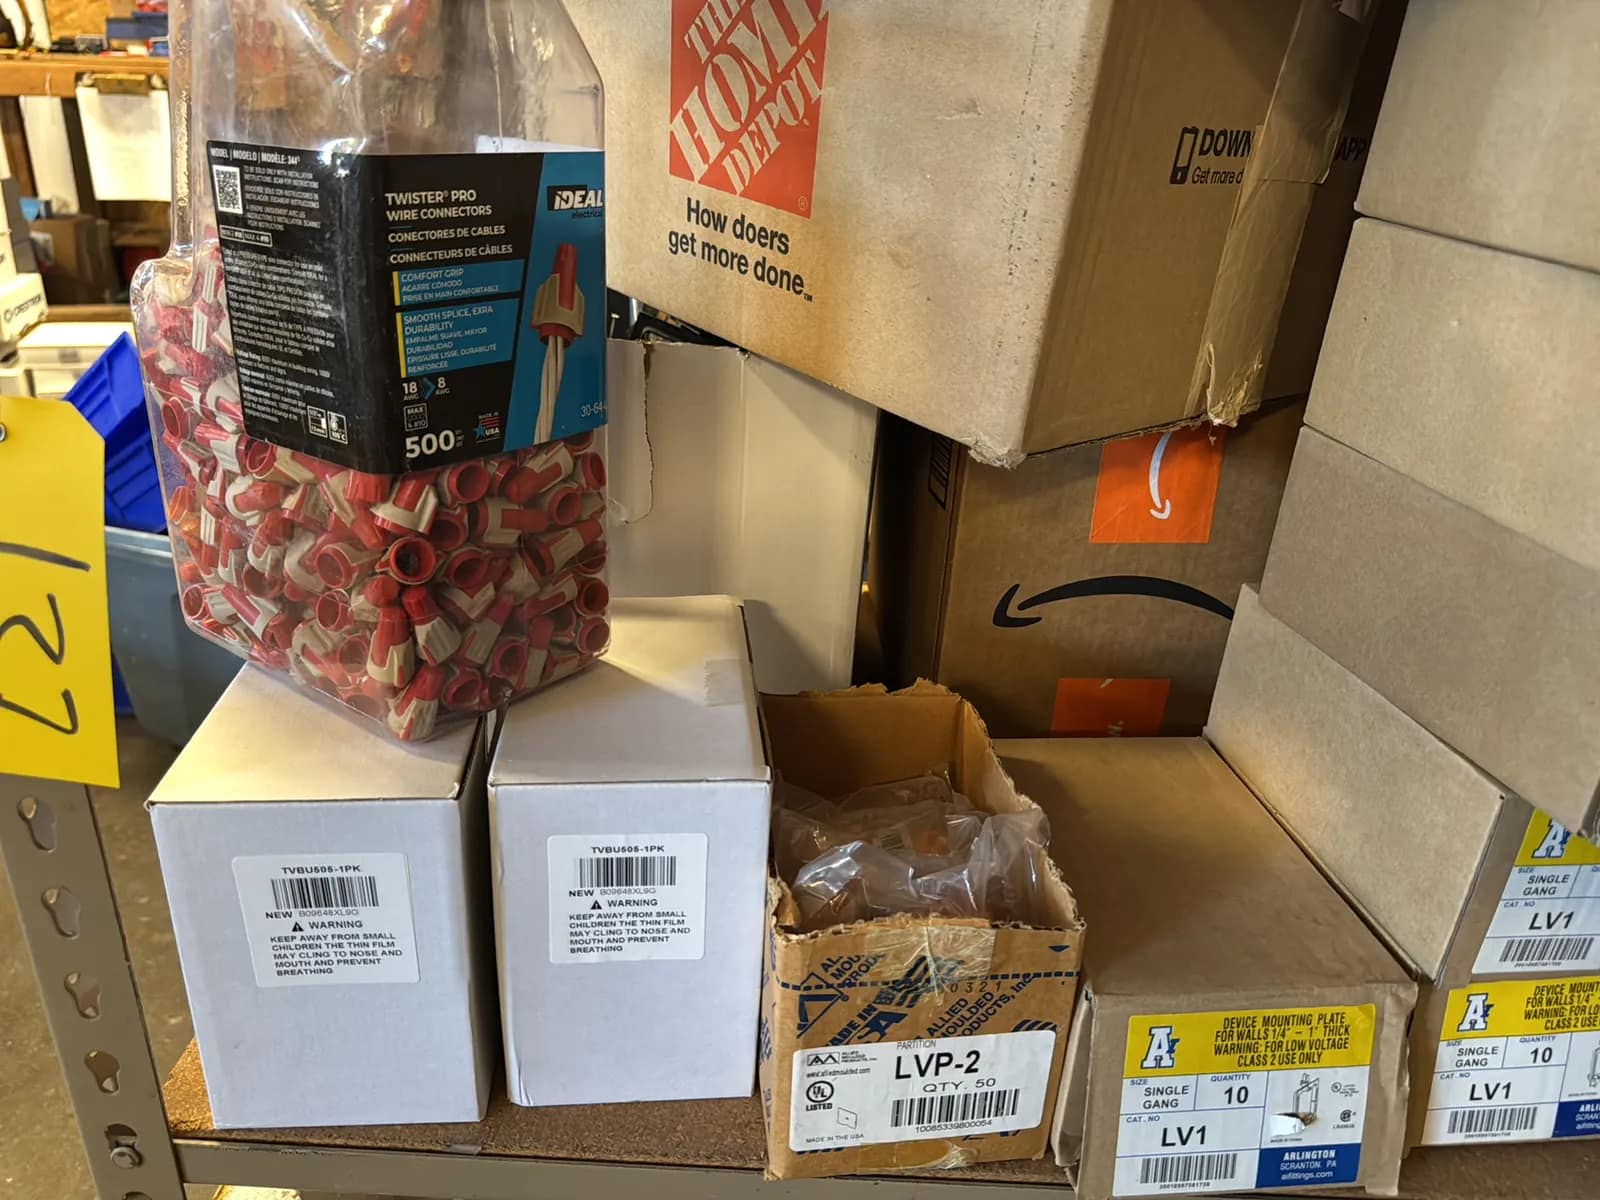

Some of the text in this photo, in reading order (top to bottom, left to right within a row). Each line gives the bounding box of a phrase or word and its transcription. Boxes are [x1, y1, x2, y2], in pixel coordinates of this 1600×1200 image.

[671, 0, 829, 184] HOM
[722, 49, 822, 197] DEPOT
[1191, 166, 1236, 184] Get more
[451, 190, 477, 202] PRO
[387, 204, 493, 222] WIRE CONNECTORS
[687, 196, 790, 256] How doers
[388, 225, 506, 244] CONECTORES DE CABLES
[390, 248, 463, 265] CONNECTEURS
[465, 248, 478, 257] DE
[668, 230, 697, 256] get
[700, 240, 750, 276] more
[401, 268, 465, 282] COMFORT GRIP
[402, 282, 430, 292] AGARRE
[423, 292, 434, 300] EN
[403, 314, 440, 325] SMOOTH
[405, 320, 454, 335] DURABILITY
[405, 334, 439, 345] EMPALME
[464, 326, 488, 336] MAYOR
[406, 341, 454, 355] DURABILIDAD
[402, 376, 447, 394] 18 8
[436, 387, 451, 395] AWG
[407, 406, 424, 415] MAX
[485, 426, 500, 436] USA
[405, 429, 455, 459] 500
[591, 845, 665, 854] TVBU505-1PK
[281, 865, 361, 875] TVBU505-1PK
[1527, 874, 1571, 885] SINGLE
[568, 889, 595, 897] NEW
[1523, 886, 1557, 896] GANG
[607, 898, 658, 908] WARNING
[265, 911, 293, 919] NEW
[569, 913, 595, 921] KEEP
[596, 912, 624, 920] AWAY
[626, 911, 653, 919] FROM
[1528, 911, 1574, 931] LV1
[308, 920, 363, 930] WARNING
[569, 920, 616, 929] CHILDREN
[663, 918, 685, 926] FILM
[270, 932, 397, 943] KEEP AWAY FROM SMALL
[569, 930, 591, 938] MAY
[593, 928, 623, 937] CLING
[640, 927, 668, 935] NOSE
[271, 940, 395, 952] CHILDREN THE THIN FILM
[569, 938, 603, 946] MOUTH
[627, 935, 670, 944] PREVENT
[273, 952, 296, 960] MAY
[298, 951, 331, 959] CLING
[333, 950, 348, 958] TO
[381, 949, 403, 957] AND
[570, 945, 623, 954] BREATHING
[275, 958, 382, 969] MOUTH AND PREVENT
[276, 967, 333, 977] BREATHING
[1534, 983, 1566, 996] DEVICE
[1526, 996, 1544, 1008] FOR
[1545, 993, 1575, 1007] WALLS
[856, 1003, 878, 1022] IN
[926, 997, 969, 1036] ALLIED
[1524, 1004, 1587, 1020] WARNING: FOR
[1223, 1011, 1346, 1030] DEVICE MOUNTING PLATE
[1544, 1015, 1599, 1031] CLASS 2 USE
[1215, 1030, 1234, 1043] FOR
[1236, 1028, 1269, 1041] WALLS
[1323, 1024, 1350, 1037] THICK
[1519, 1035, 1556, 1044] QUANTITY
[896, 1040, 937, 1051] PARTITION
[1214, 1037, 1350, 1057] WARNING: FOR LOW VOLTAGE
[1237, 1051, 1323, 1067] CLASS 2 USE ONLY
[1456, 1046, 1553, 1064] SINGLE 10
[895, 1050, 981, 1081] LVP-2
[1455, 1057, 1488, 1068] GANG
[975, 1077, 997, 1090] 50
[1210, 1073, 1251, 1083] QUANTITY
[1144, 1084, 1250, 1105] SINGLE 10
[1469, 1081, 1512, 1101] LV1
[805, 1103, 833, 1112] LISTED
[1142, 1099, 1180, 1110] GANG
[805, 1136, 825, 1144] MADE
[1161, 1125, 1208, 1147] LV1
[1283, 1149, 1336, 1161] ARLINGTON
[1326, 1159, 1337, 1168] PA
